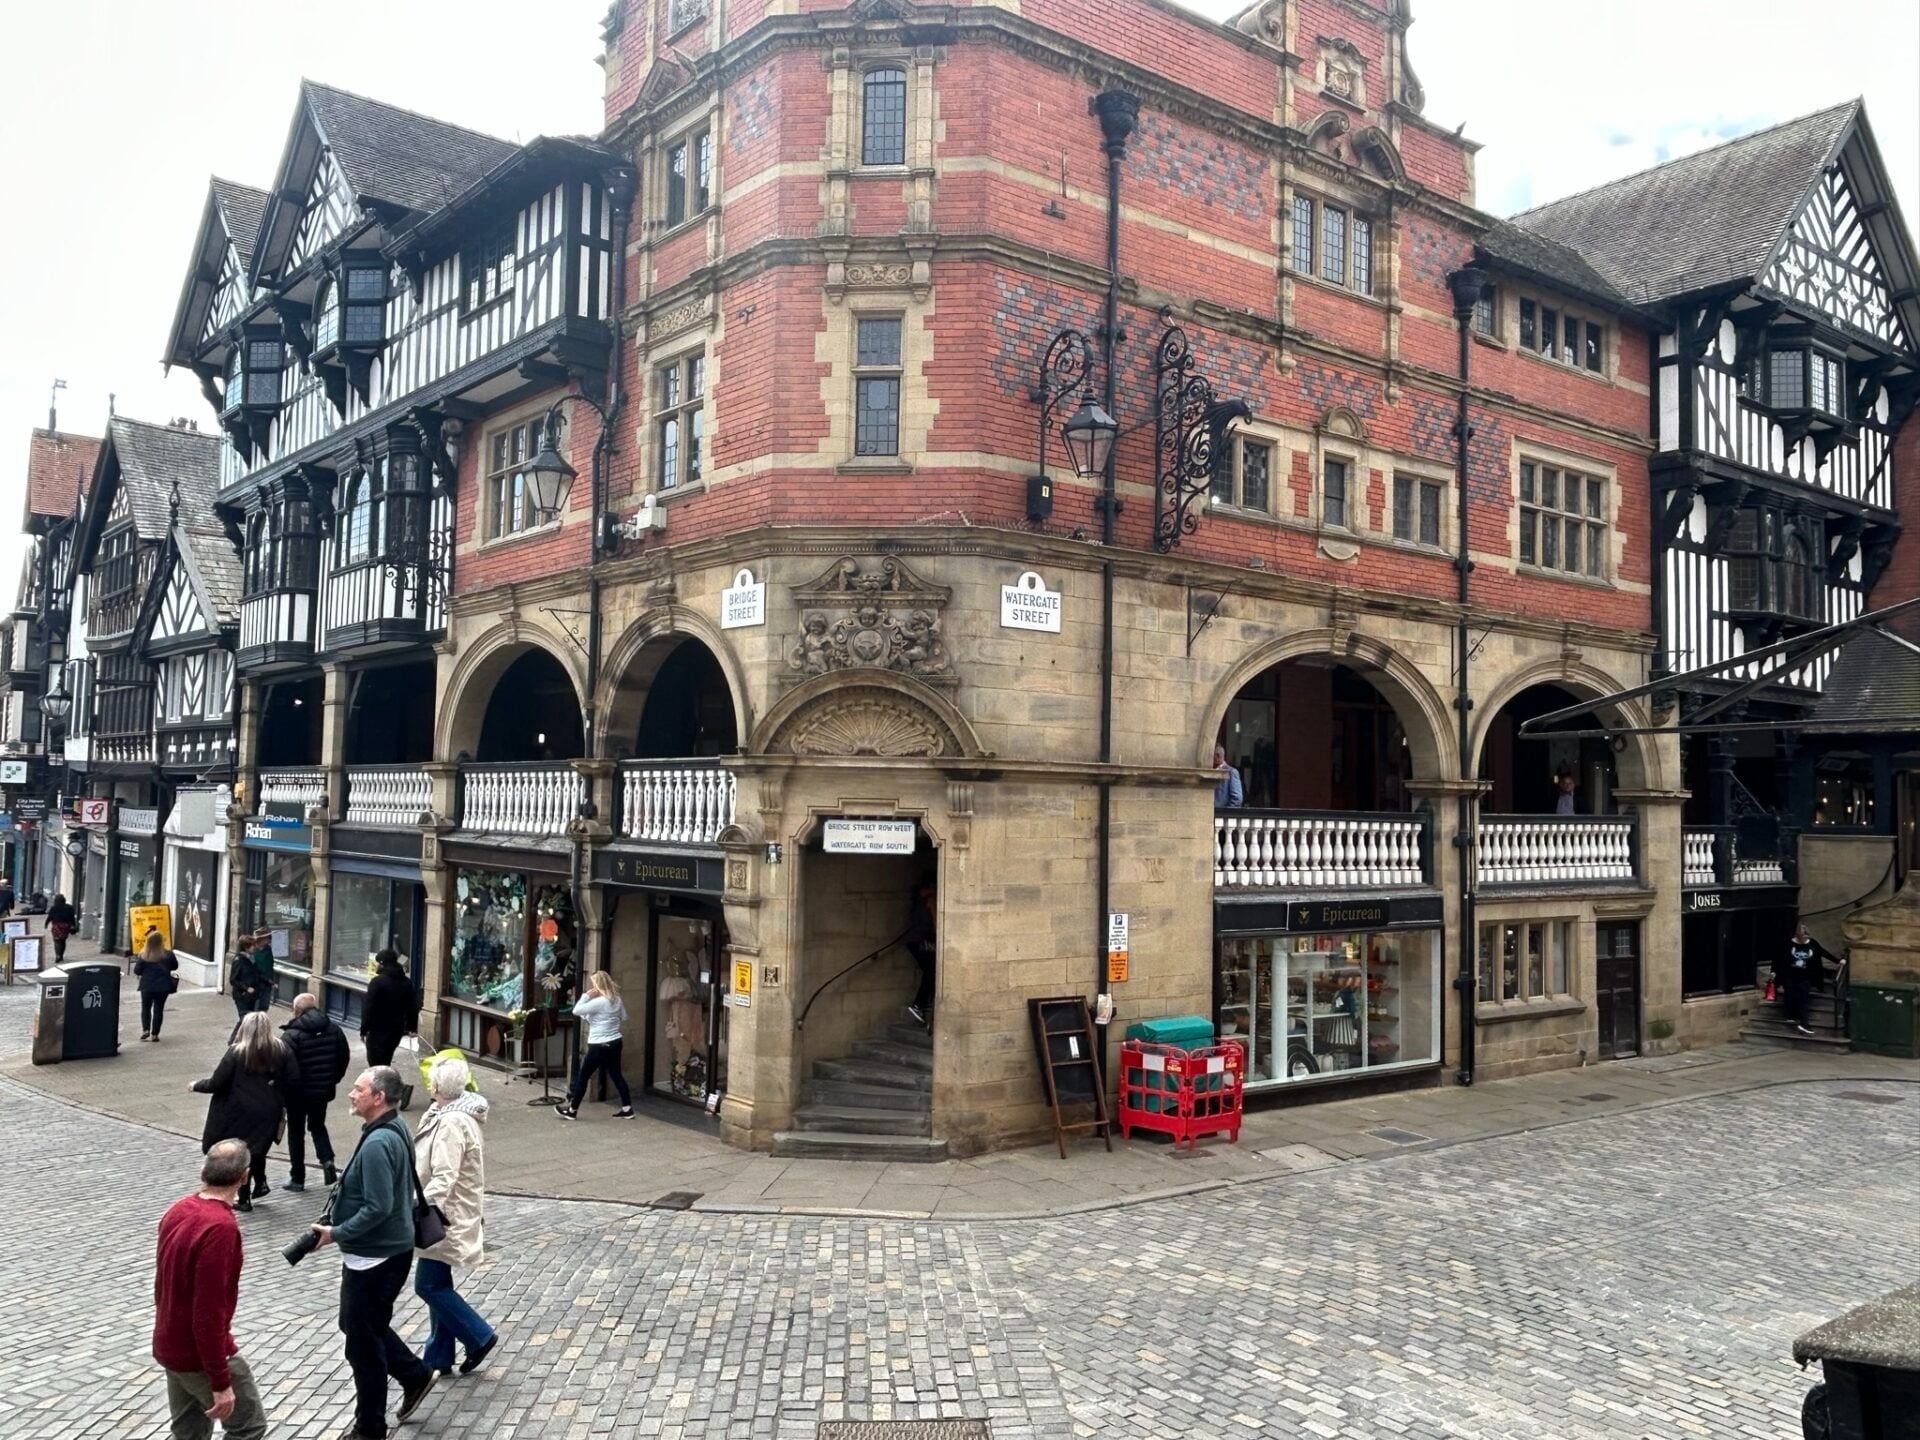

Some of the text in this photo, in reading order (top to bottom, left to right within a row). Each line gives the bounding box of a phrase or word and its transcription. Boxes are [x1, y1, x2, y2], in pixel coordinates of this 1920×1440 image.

[729, 590, 757, 606] BRIDGE
[1005, 591, 1059, 610] WATERGATE
[729, 606, 757, 621] STREET
[1012, 609, 1050, 625] STREET
[265, 814, 298, 823] Rohan
[245, 822, 272, 840] Rohan
[828, 823, 913, 832] BRIDGE STREET ROW WEST
[831, 841, 866, 849] WATERGATE
[886, 842, 909, 850] SOUTH
[635, 860, 689, 881] Epicurean
[1322, 907, 1382, 926] Epicurean
